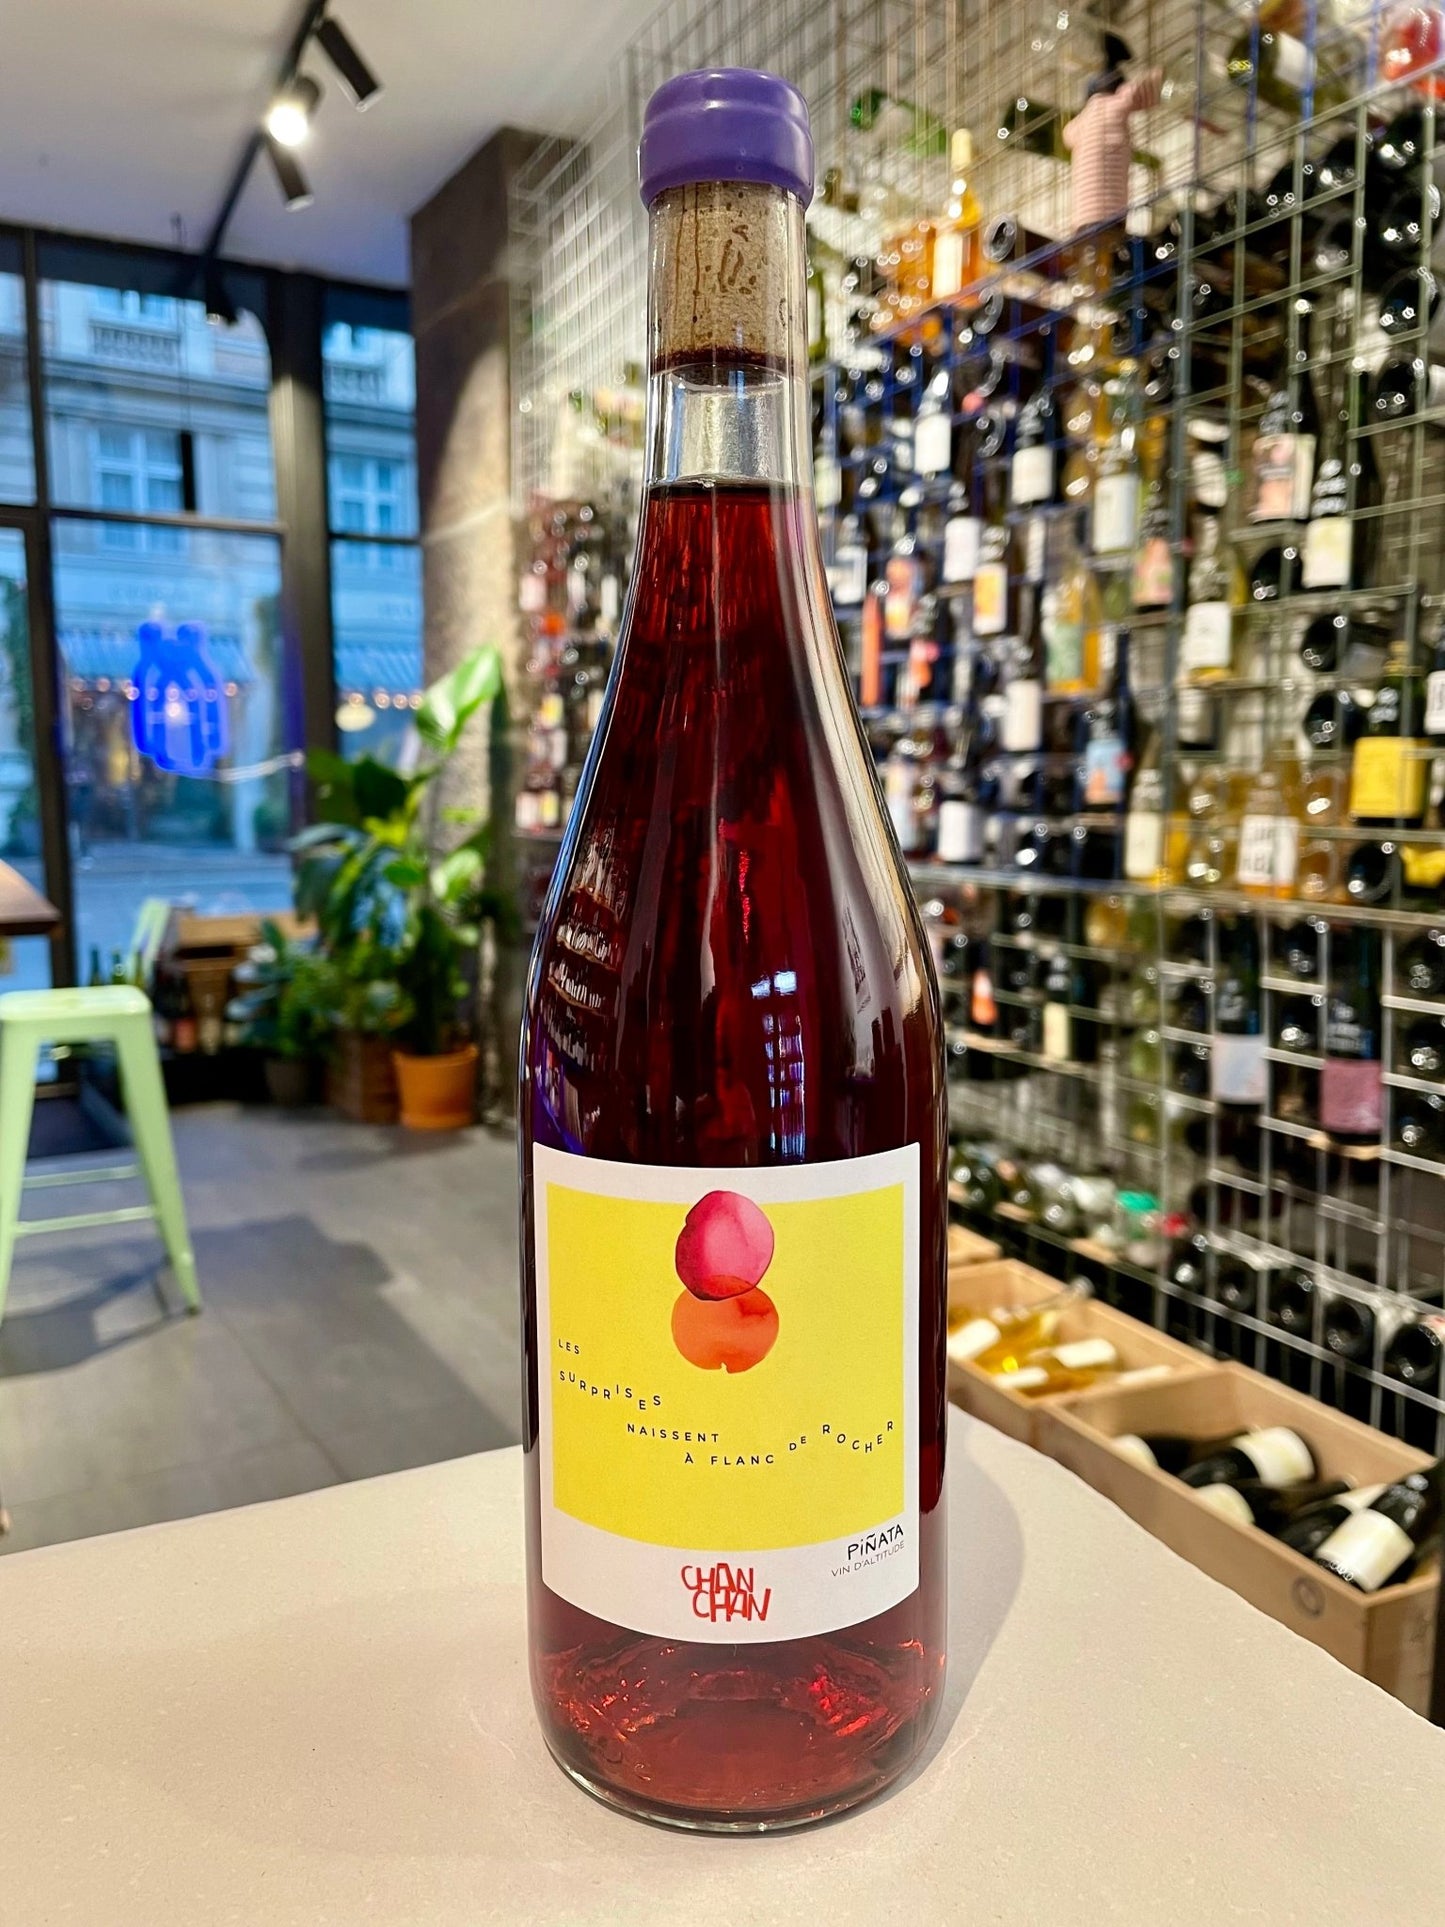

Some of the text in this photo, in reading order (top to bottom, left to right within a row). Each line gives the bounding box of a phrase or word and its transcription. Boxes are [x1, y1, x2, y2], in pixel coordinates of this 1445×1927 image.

[558, 1338, 581, 1355] LES
[558, 1370, 662, 1411] SURPRISES
[627, 1423, 719, 1443] NAISSENT
[684, 1420, 895, 1466] À FLANC DE ROCHER
[831, 1540, 905, 1577] VIN D'ALTITUDE
[681, 1562, 754, 1594] CHAN
[692, 1587, 771, 1622] CHAN
